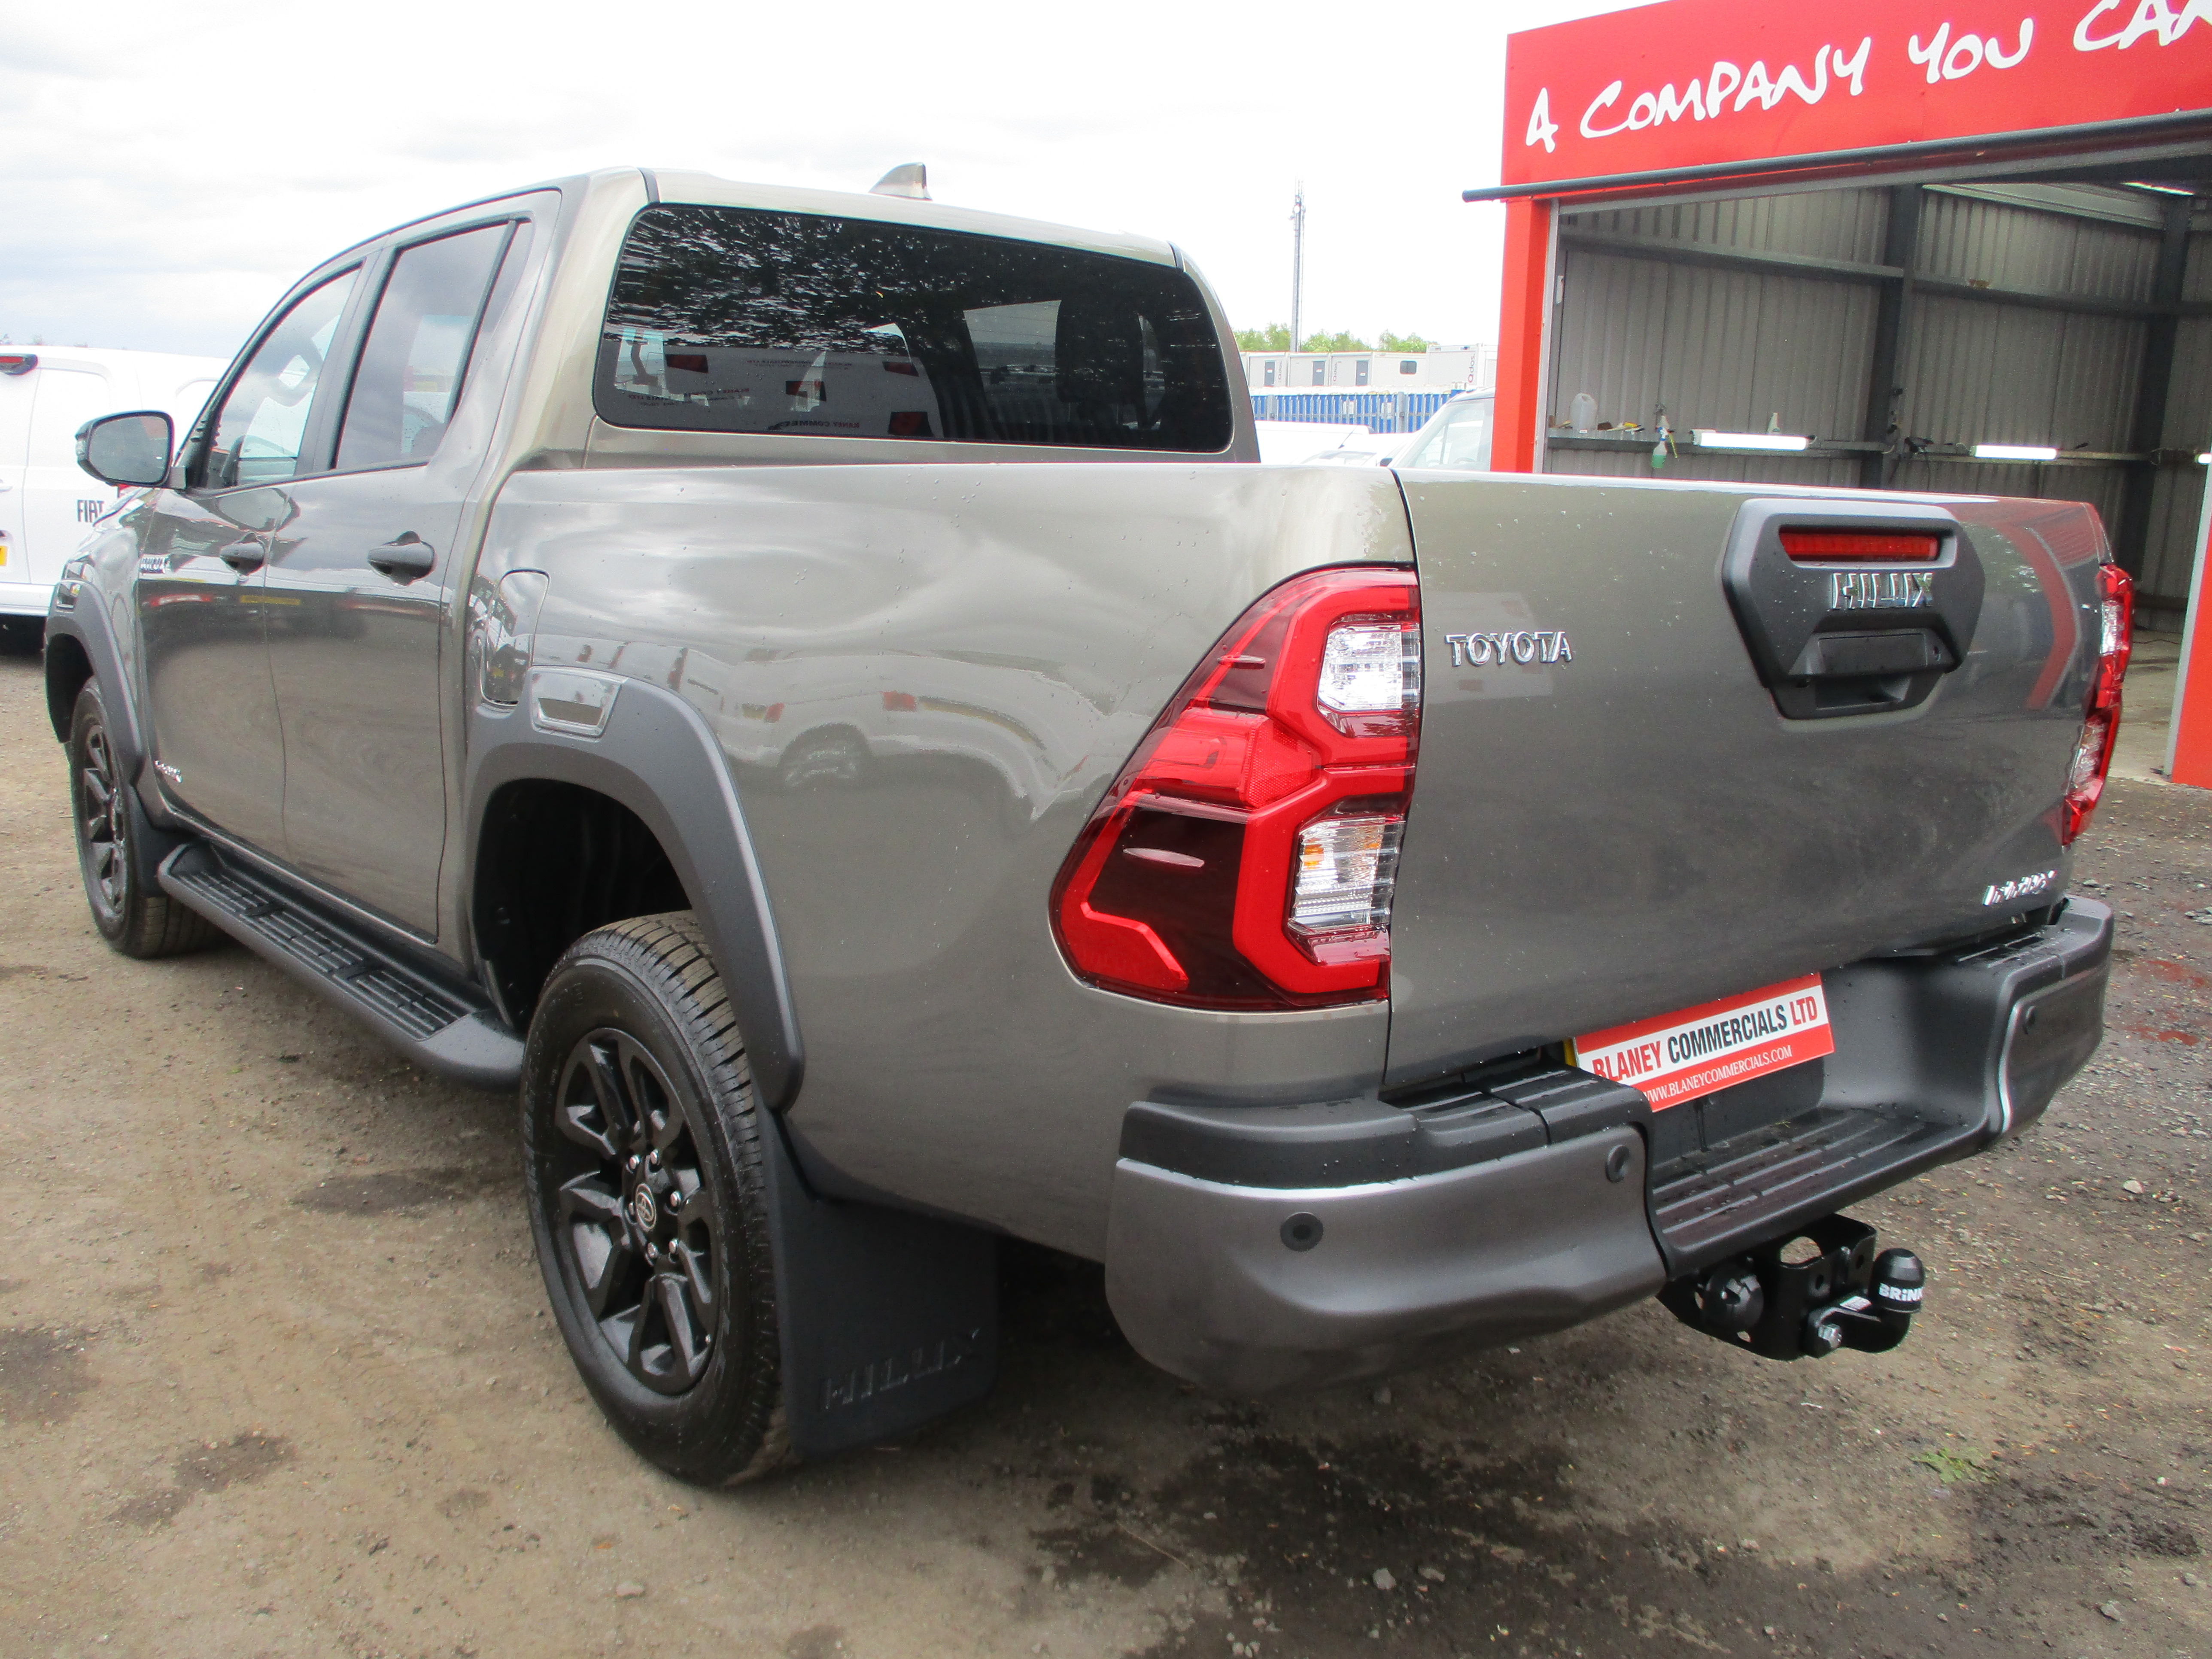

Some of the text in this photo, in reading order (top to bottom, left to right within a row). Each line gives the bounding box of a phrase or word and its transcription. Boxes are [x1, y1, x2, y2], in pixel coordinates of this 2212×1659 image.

[1526, 87, 1558, 153] A
[1580, 37, 1871, 140] COMPANY
[1909, 18, 2034, 84] YOU
[77, 499, 105, 523] FIAT
[1832, 572, 1934, 609] HILUX
[1445, 630, 1572, 667] TOYOTA
[1592, 996, 1818, 1082] BLANEY COMMERCIALS LTD
